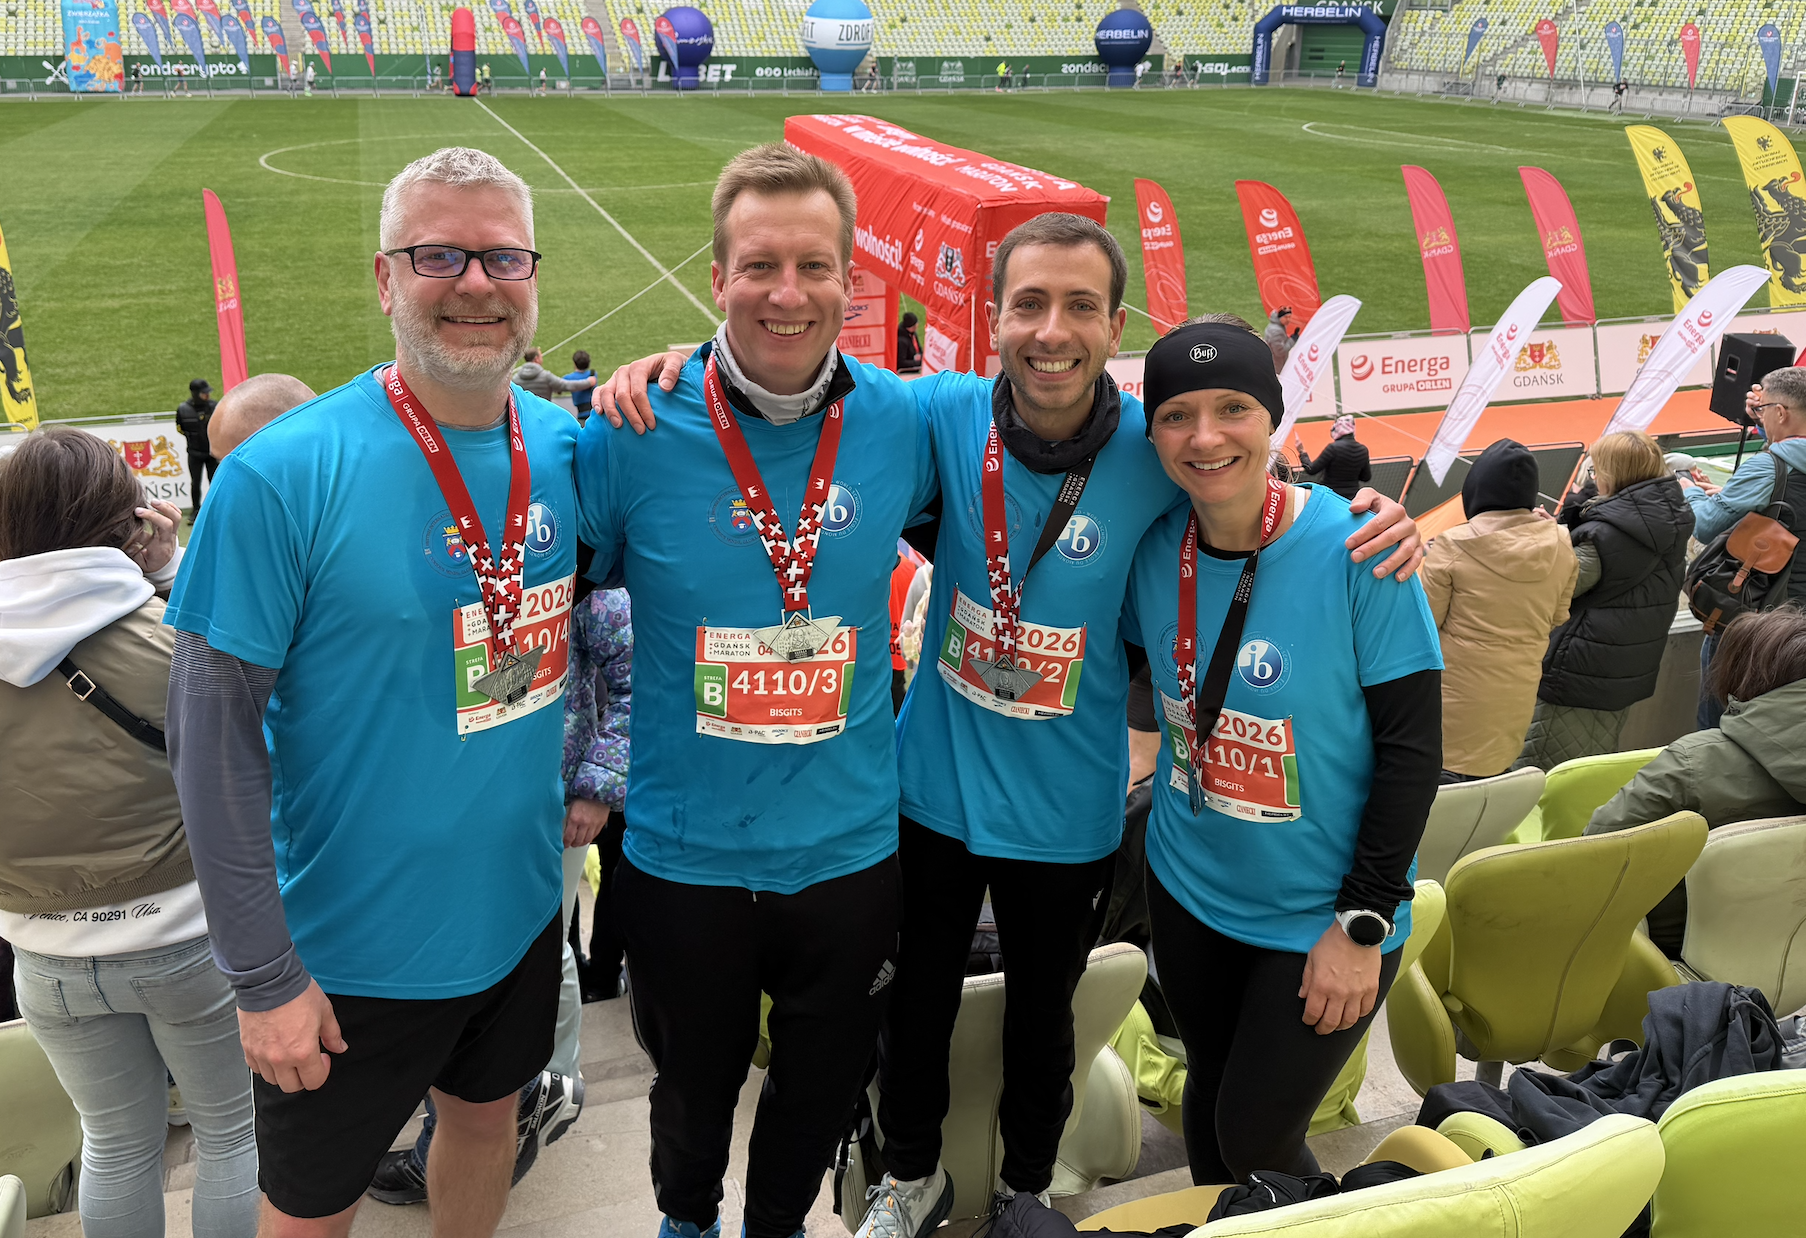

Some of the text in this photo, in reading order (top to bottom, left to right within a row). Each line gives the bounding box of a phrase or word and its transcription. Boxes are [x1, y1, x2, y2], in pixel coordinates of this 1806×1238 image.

[1281, 6, 1362, 18] HERBELIN
[854, 224, 903, 272] wolności!
[1683, 318, 1706, 346] Energa
[1380, 356, 1450, 377] Energa
[708, 378, 719, 403] GRUPA
[1382, 379, 1452, 394] GRUPA ORLEN
[1513, 372, 1564, 388] GDAŃSK
[713, 401, 731, 430] ORLEN
[402, 403, 421, 427] GRUPA
[416, 425, 440, 454] ORLEN
[145, 481, 188, 499] ŃSK
[1264, 491, 1281, 533] Energa
[526, 584, 574, 618] 2026
[709, 632, 751, 640] ENERGA
[947, 634, 962, 659] B
[1016, 625, 1078, 653] 2026
[465, 656, 484, 665] STREFA
[703, 682, 723, 706] B
[731, 668, 838, 697] 4110/3
[769, 707, 803, 717] BISGITS
[1217, 713, 1283, 747] 2026
[1214, 777, 1245, 793] BISGITS
[73, 911, 88, 922] CA
[91, 909, 127, 923] 90291
[868, 965, 897, 996] adidas
